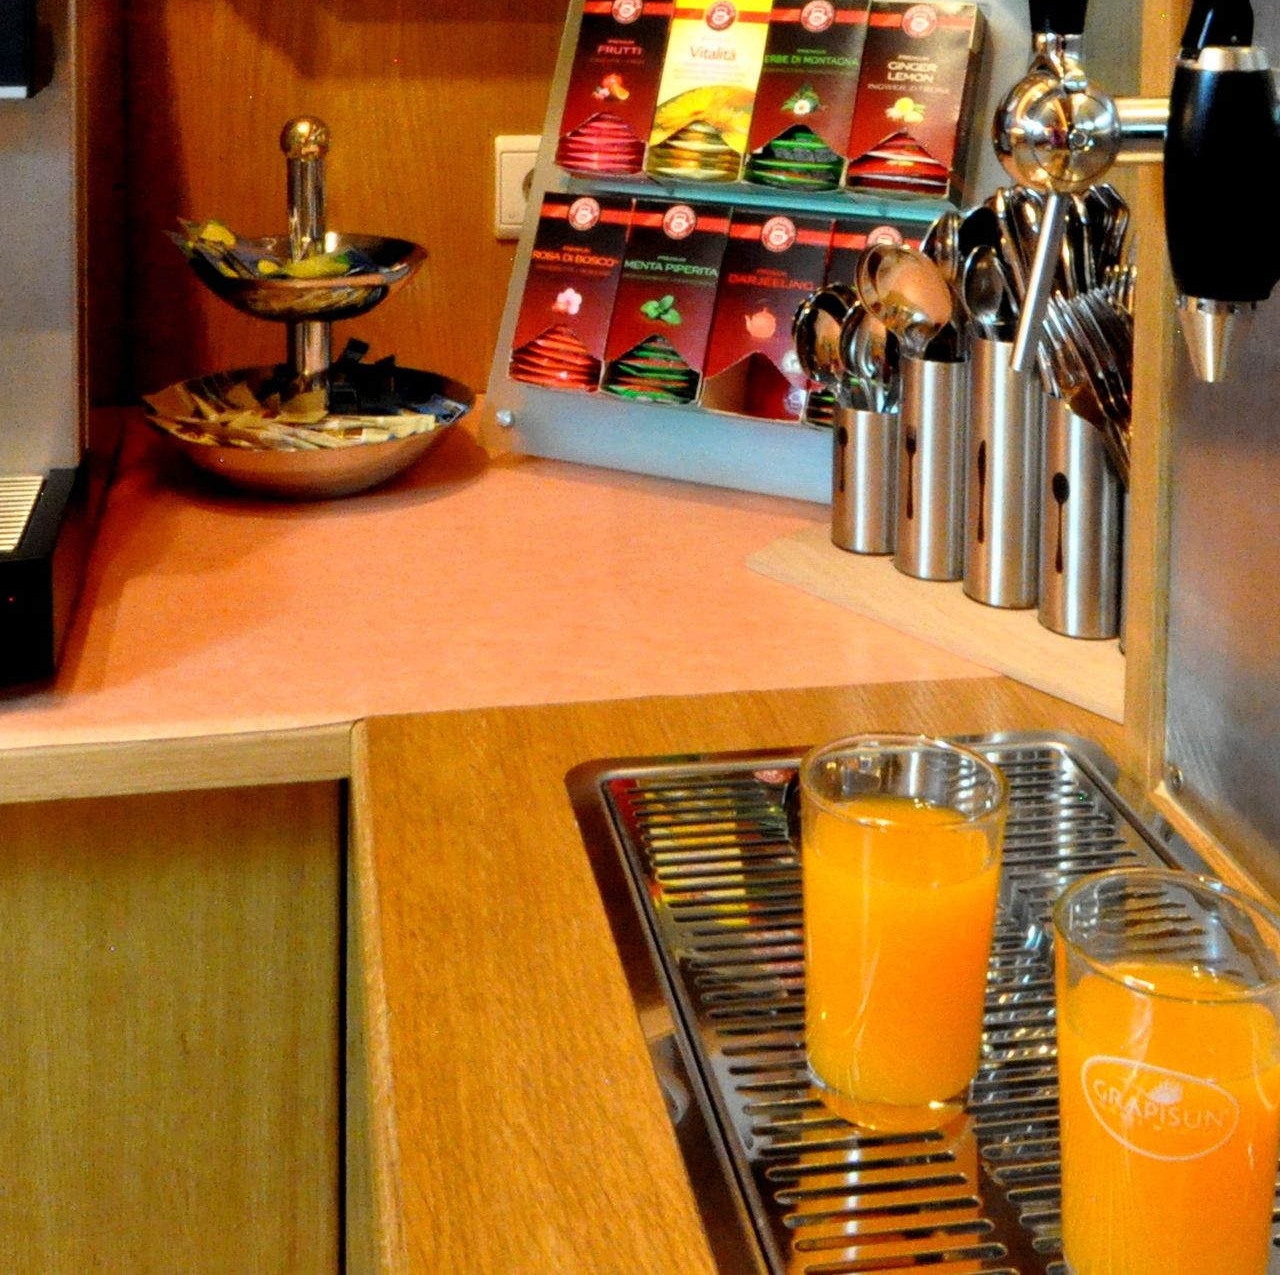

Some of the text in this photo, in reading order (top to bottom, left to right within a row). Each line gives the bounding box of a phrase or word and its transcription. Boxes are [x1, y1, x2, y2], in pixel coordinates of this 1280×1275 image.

[596, 45, 644, 57] FRUTTI
[887, 60, 939, 73] GINGER
[887, 72, 935, 83] LEMON
[575, 253, 616, 268] BOSCO
[623, 259, 663, 272] MENTA
[665, 263, 719, 277] PIPERITA
[1092, 1079, 1224, 1130] GRAPISUN
